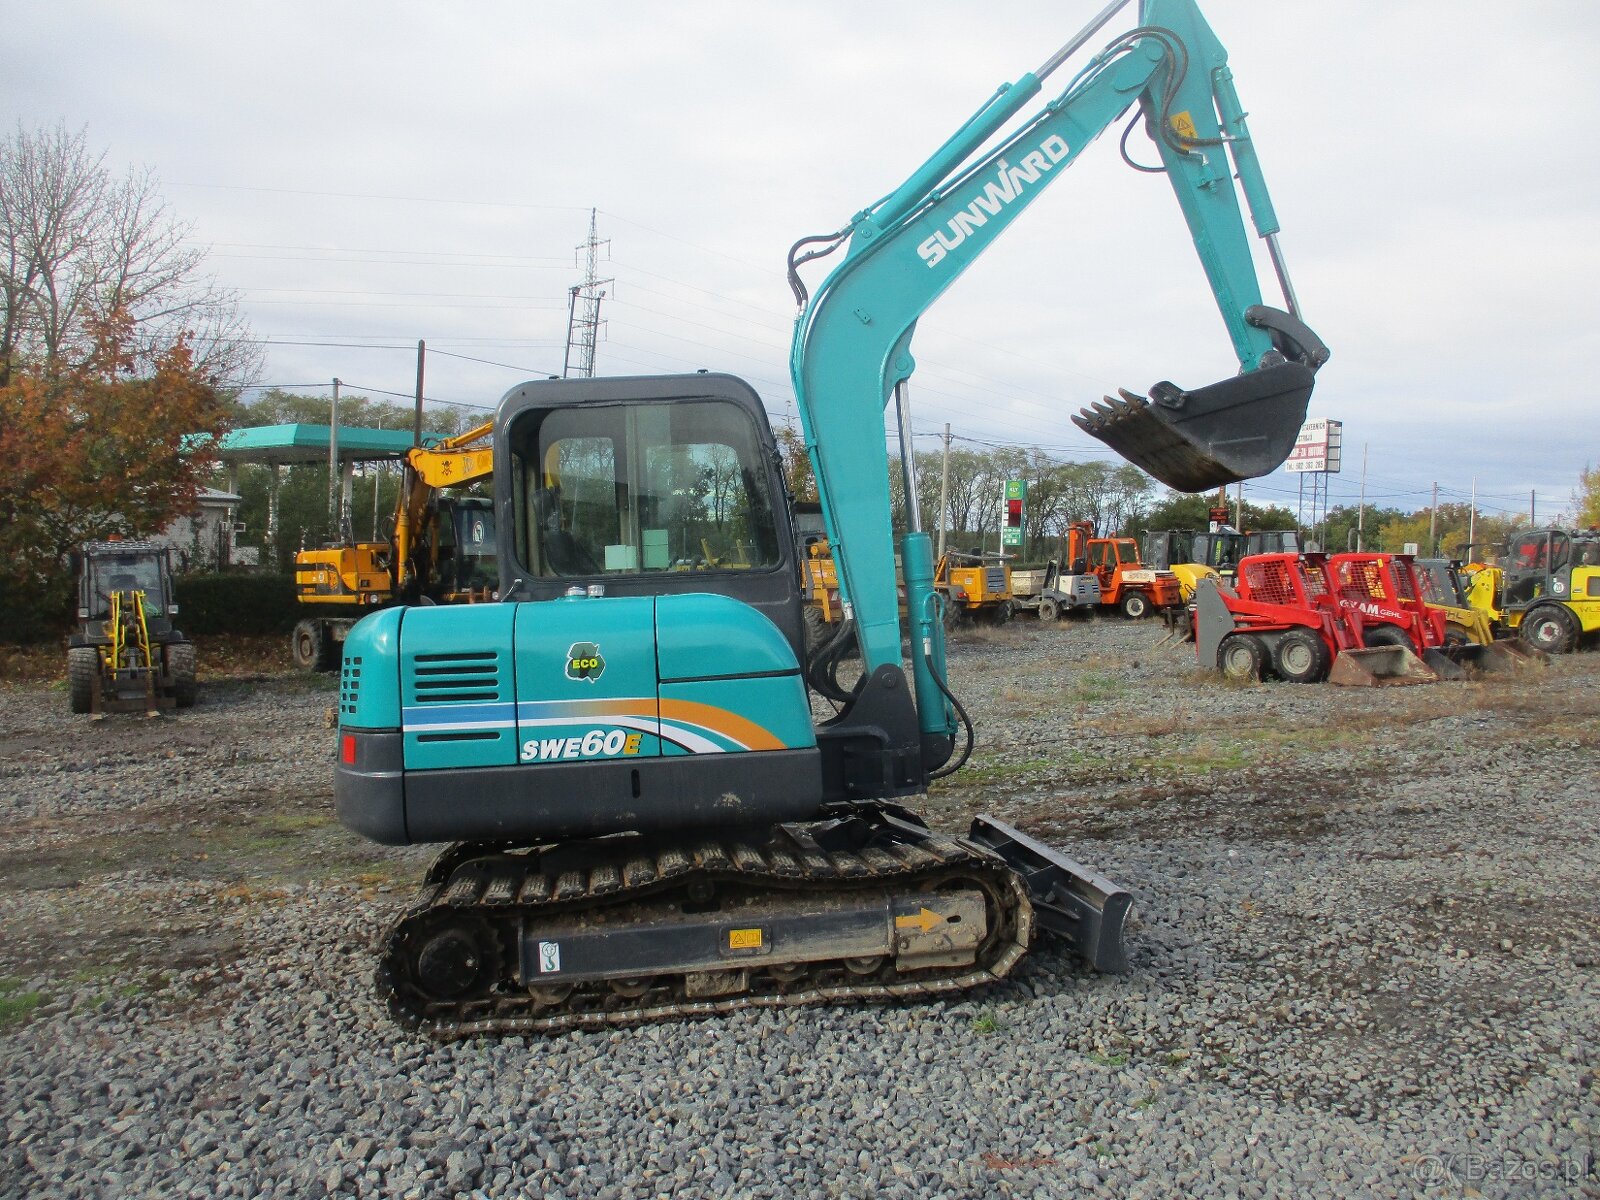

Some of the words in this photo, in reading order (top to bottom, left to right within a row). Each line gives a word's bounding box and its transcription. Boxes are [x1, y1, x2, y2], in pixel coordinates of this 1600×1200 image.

[917, 134, 1070, 269] SUNWARD
[1380, 609, 1402, 619] GEHL
[572, 658, 598, 669] ECO
[520, 729, 644, 761] SWE60E
